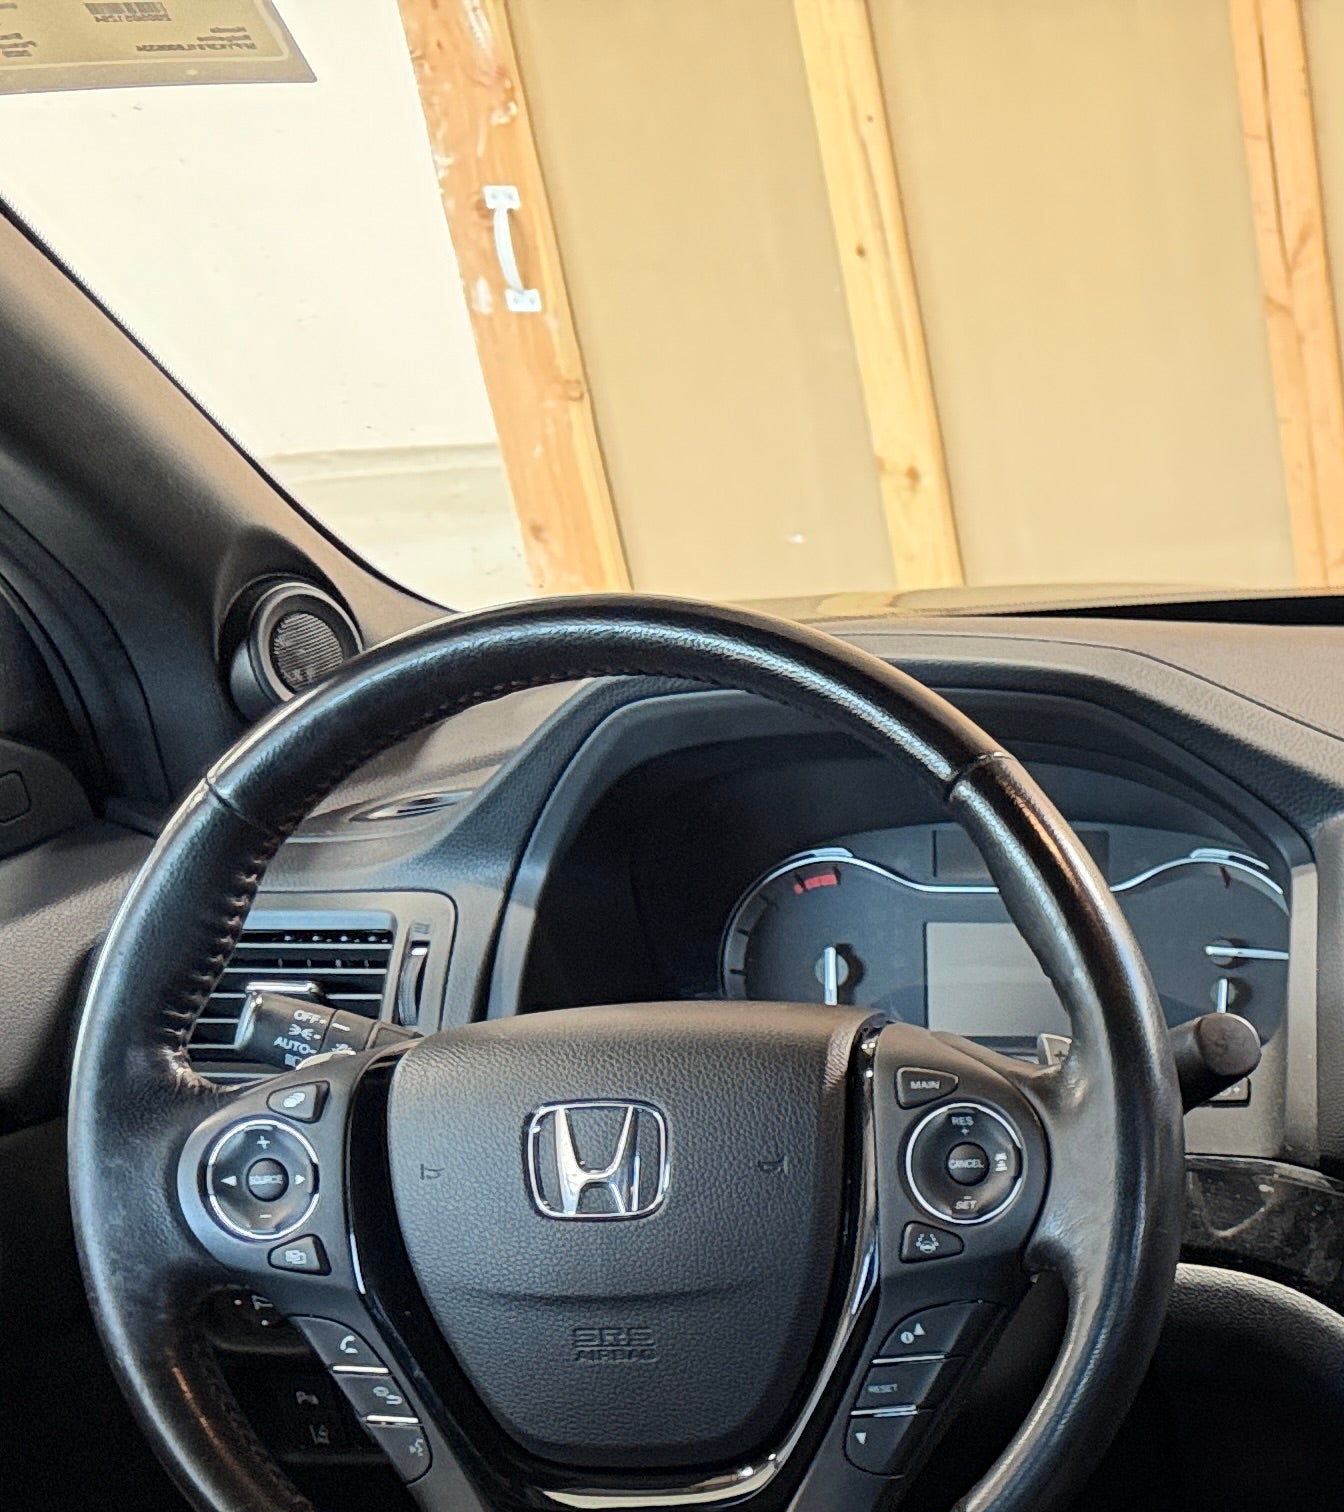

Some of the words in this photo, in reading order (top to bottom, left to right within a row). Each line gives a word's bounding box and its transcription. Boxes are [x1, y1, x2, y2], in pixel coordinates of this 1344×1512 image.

[293, 1009, 321, 1024] OFF
[273, 1036, 311, 1055] AUTO
[910, 1081, 940, 1090] MAIN
[951, 1116, 974, 1126] RES
[948, 1159, 984, 1170] CANCEL
[248, 1175, 284, 1186] SOURCE
[955, 1200, 977, 1210] SET
